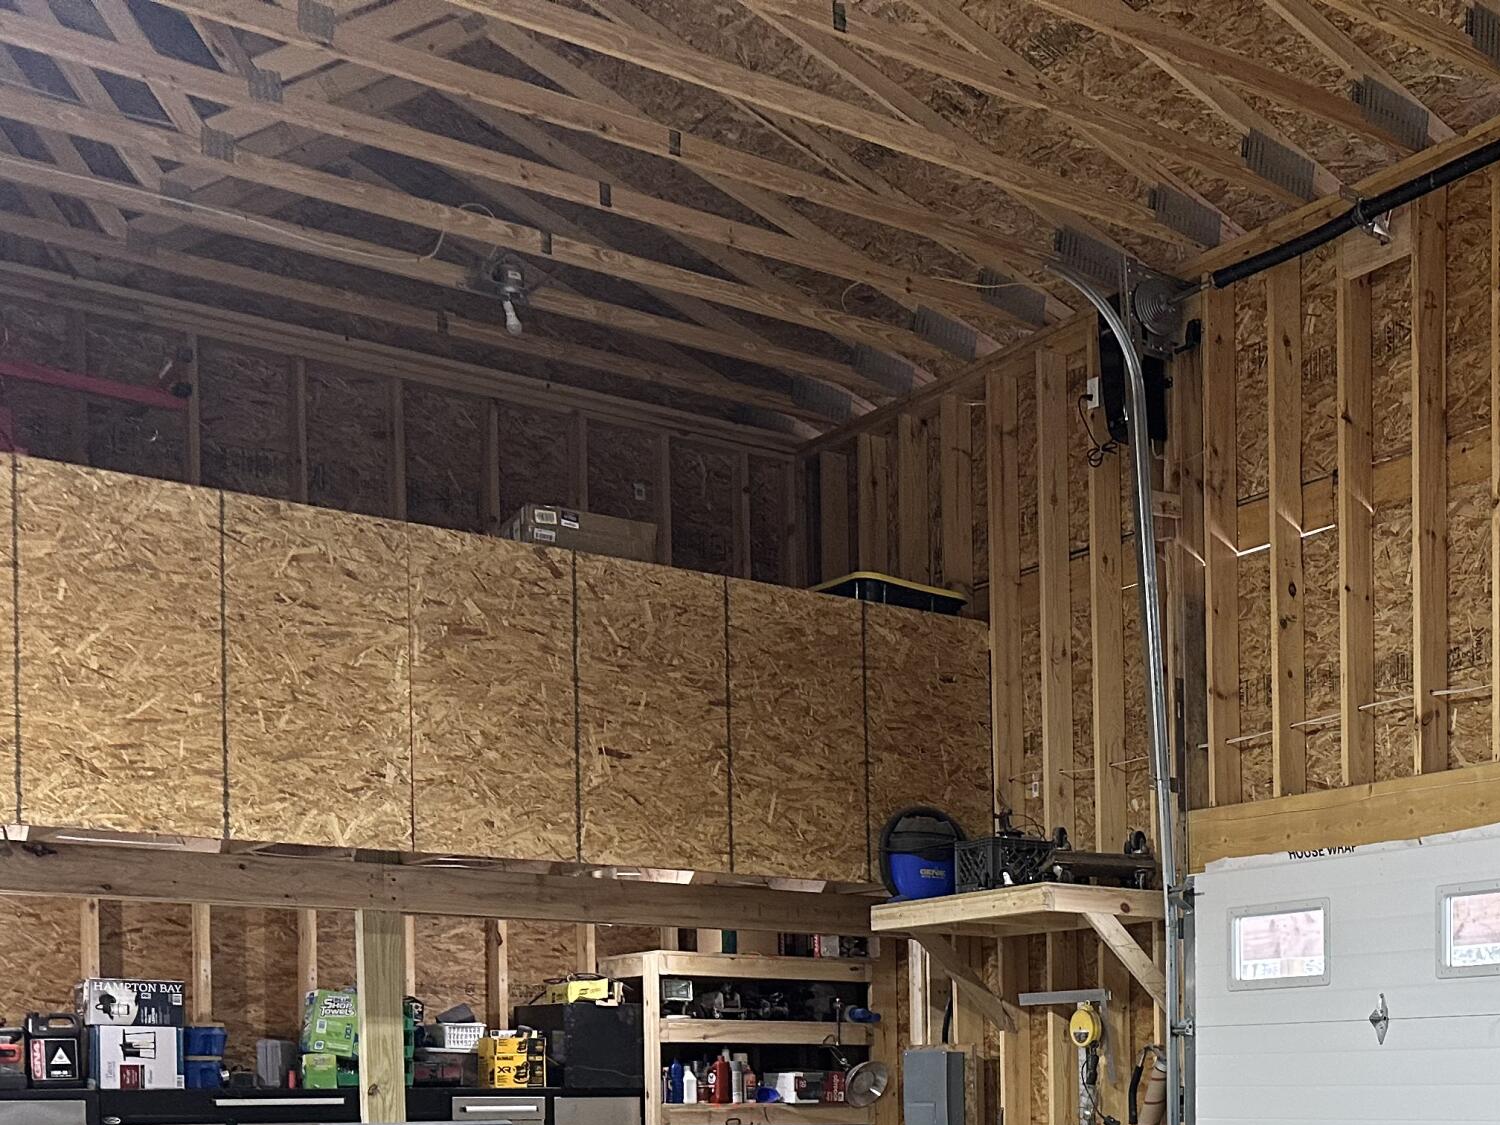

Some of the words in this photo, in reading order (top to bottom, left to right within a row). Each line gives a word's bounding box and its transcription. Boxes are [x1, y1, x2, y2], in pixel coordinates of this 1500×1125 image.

[1287, 848, 1325, 860] HOUSE
[93, 981, 158, 992] HAMPTON
[159, 983, 183, 993] BAY
